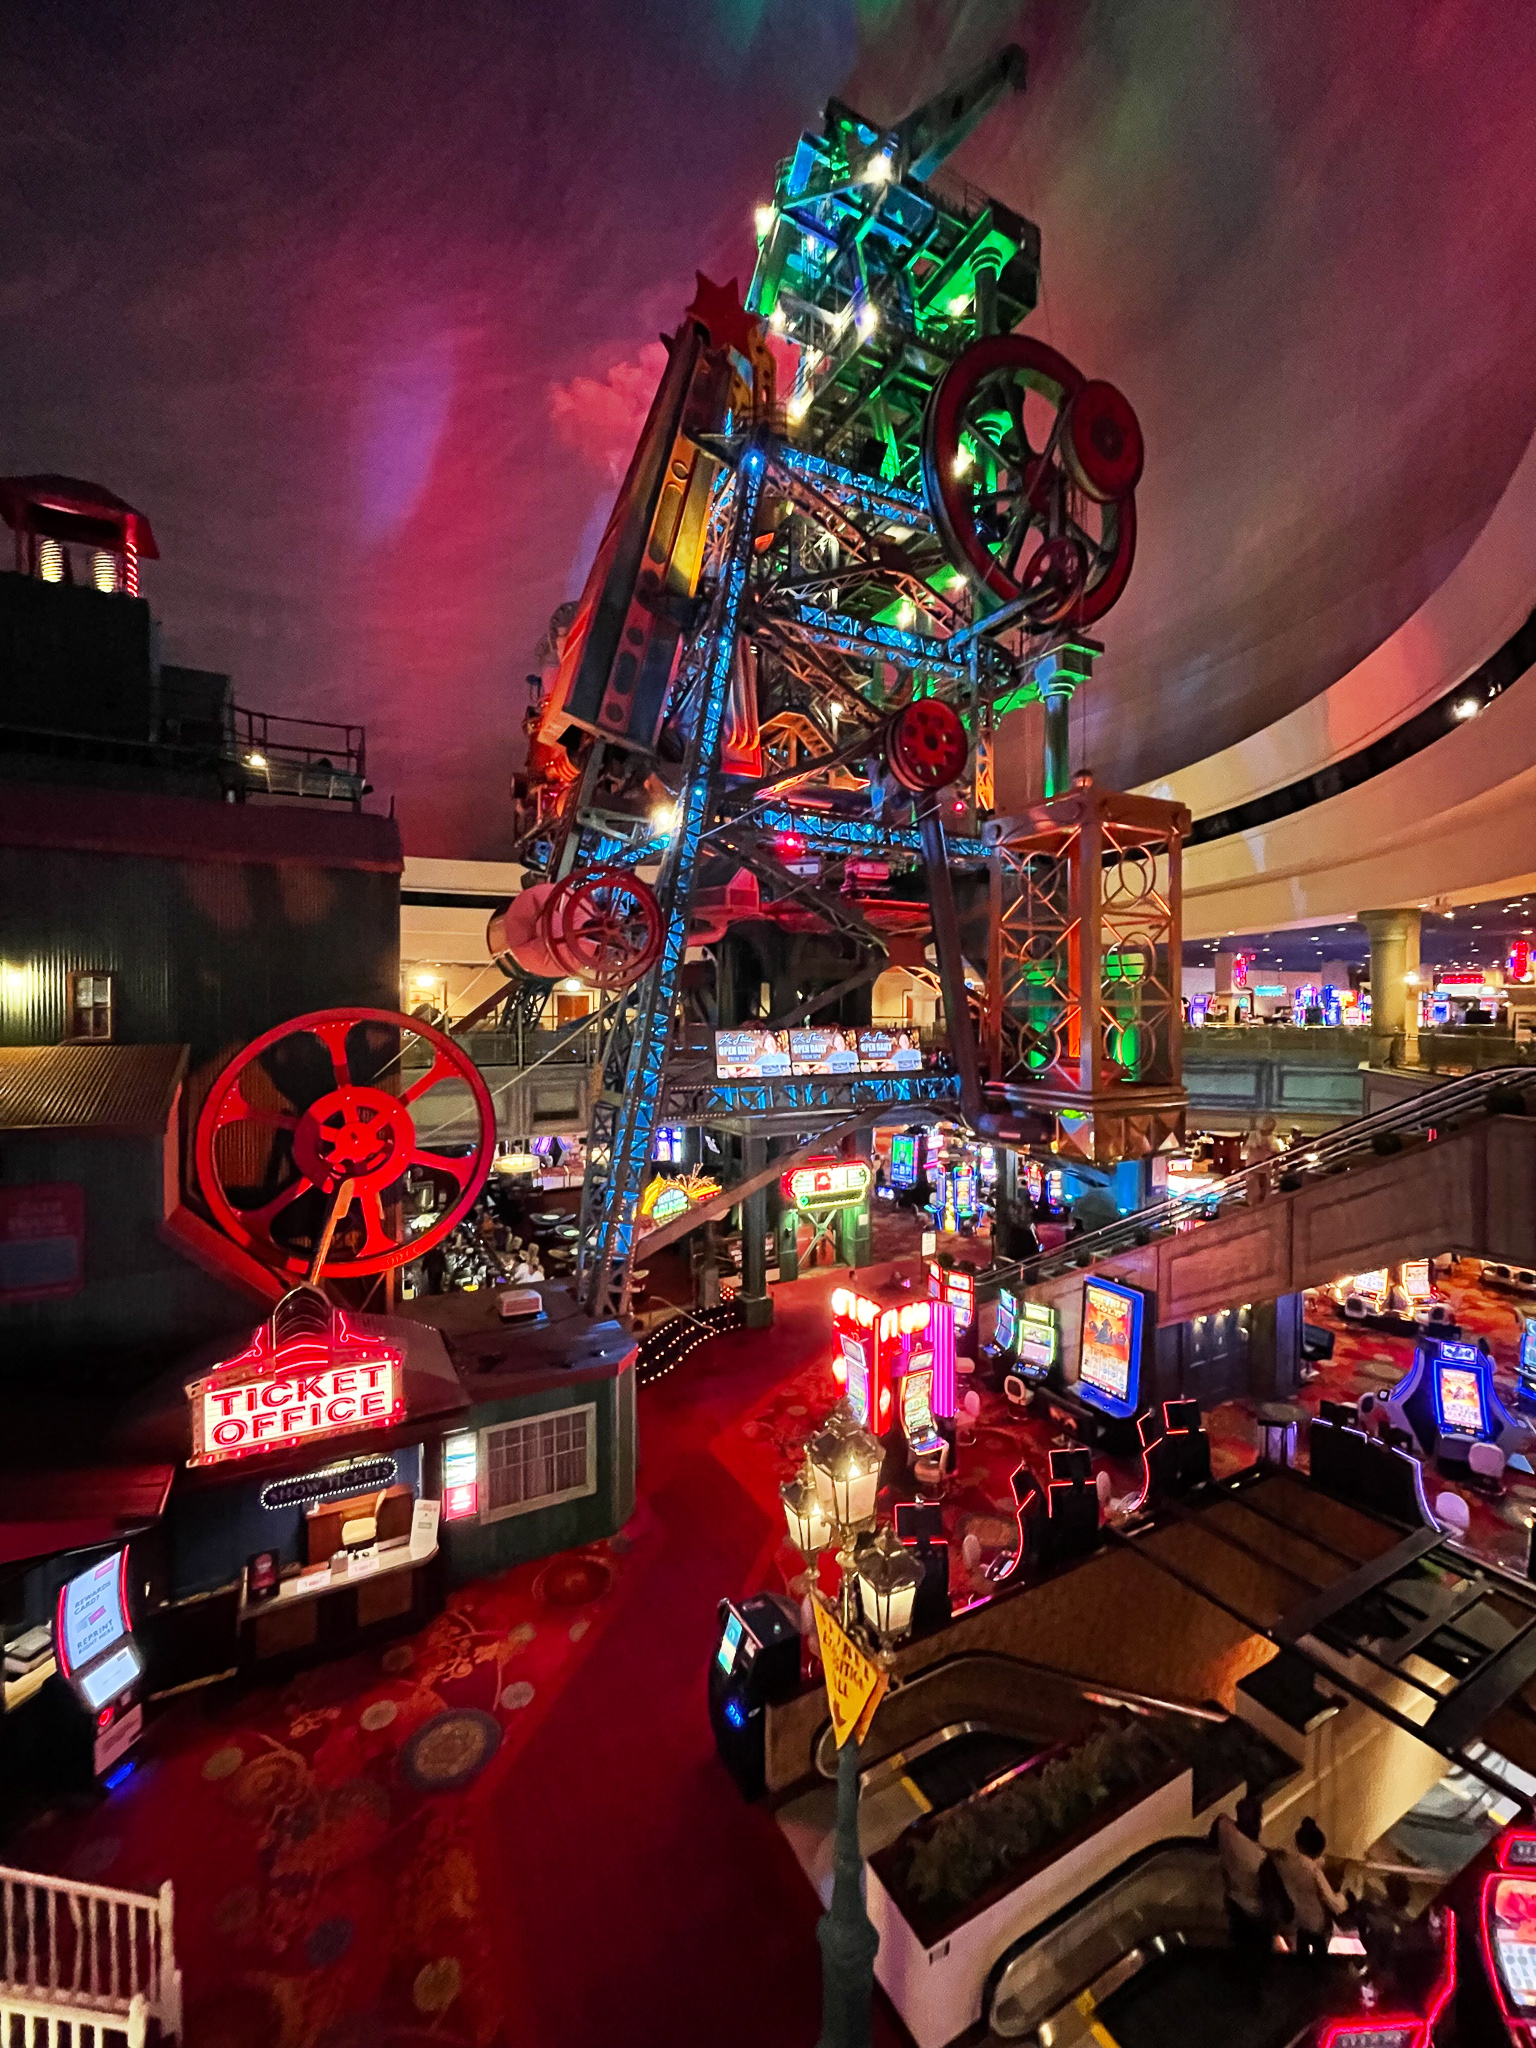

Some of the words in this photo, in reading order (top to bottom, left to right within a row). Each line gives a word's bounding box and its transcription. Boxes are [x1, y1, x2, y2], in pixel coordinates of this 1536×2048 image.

[211, 1364, 387, 1417] TICKET
[211, 1391, 386, 1446] OFFICE
[269, 1481, 320, 1500] SHOW
[327, 1463, 390, 1489] TICKETS
[75, 1580, 111, 1608] REWARDS
[77, 1619, 113, 1649] REPRINT
